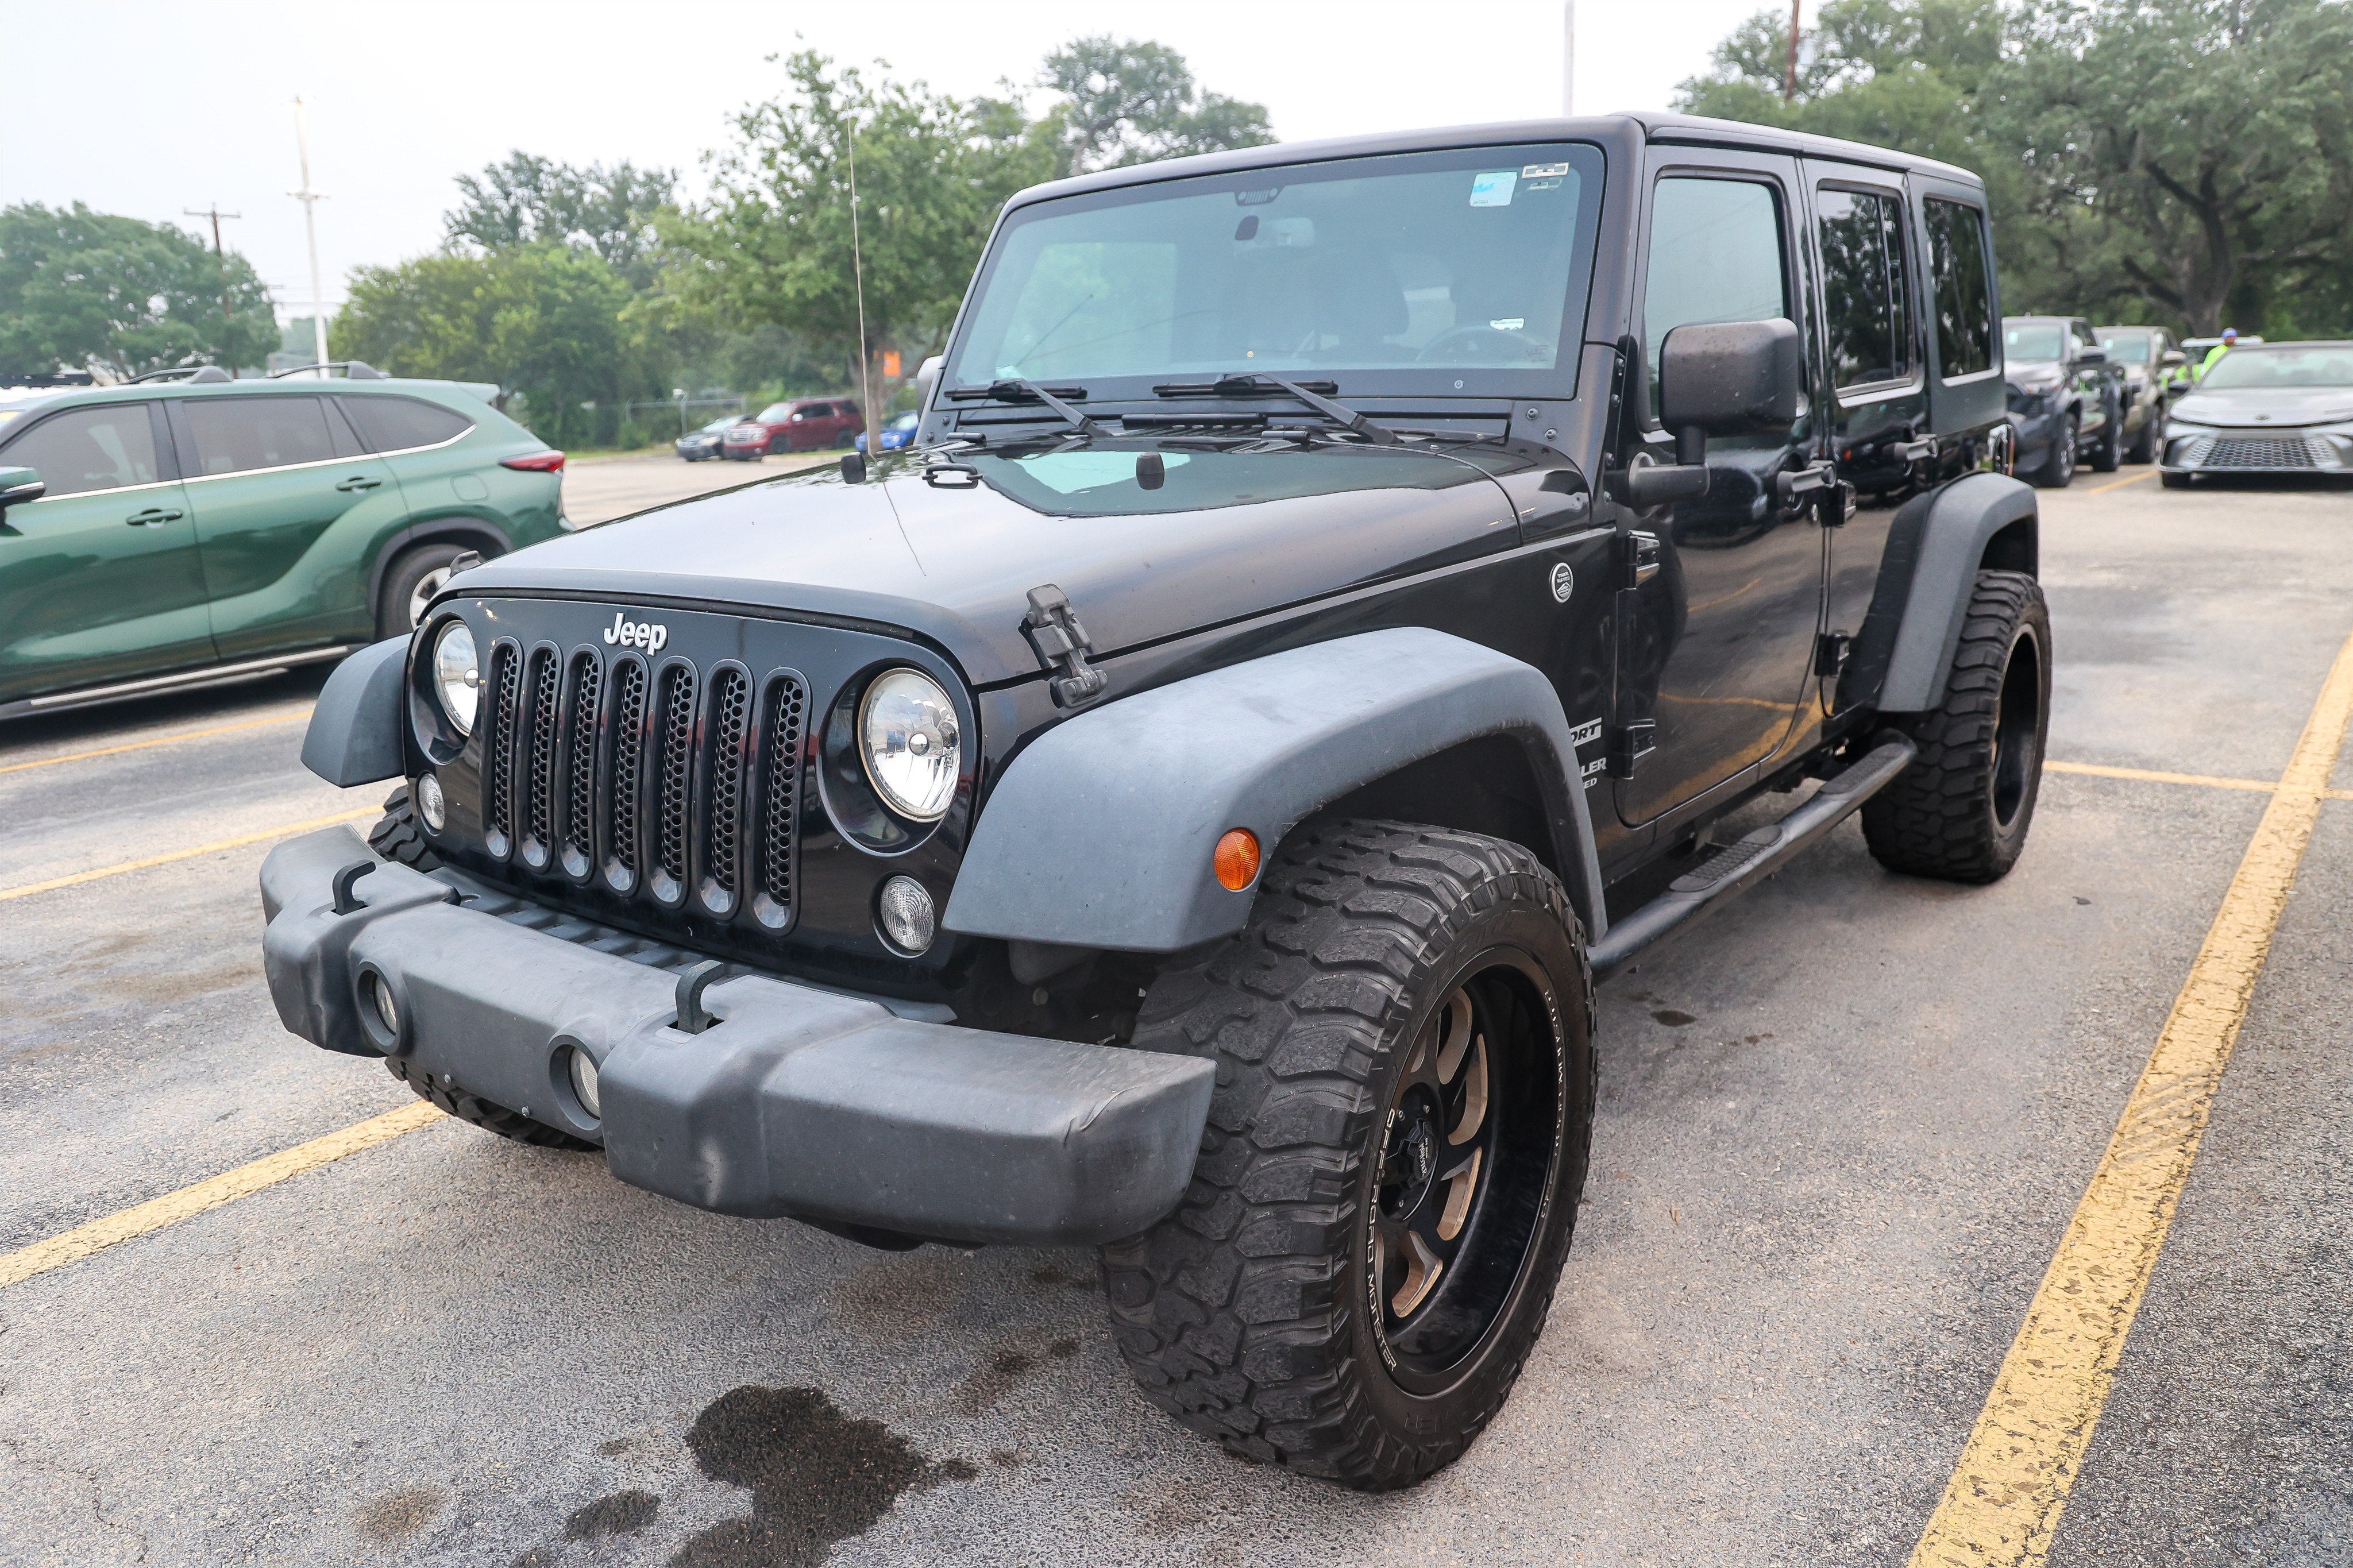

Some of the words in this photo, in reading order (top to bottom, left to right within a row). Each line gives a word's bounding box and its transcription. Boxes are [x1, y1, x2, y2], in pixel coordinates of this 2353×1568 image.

[604, 612, 668, 656] Jeep
[1571, 721, 1602, 743] ORT
[1580, 757, 1607, 778] LER
[1584, 777, 1598, 789] ED
[1418, 1142, 1428, 1177] MONSTER
[1367, 1108, 1395, 1264] OFF-ROAD
[1368, 1268, 1397, 1372] MONSTER
